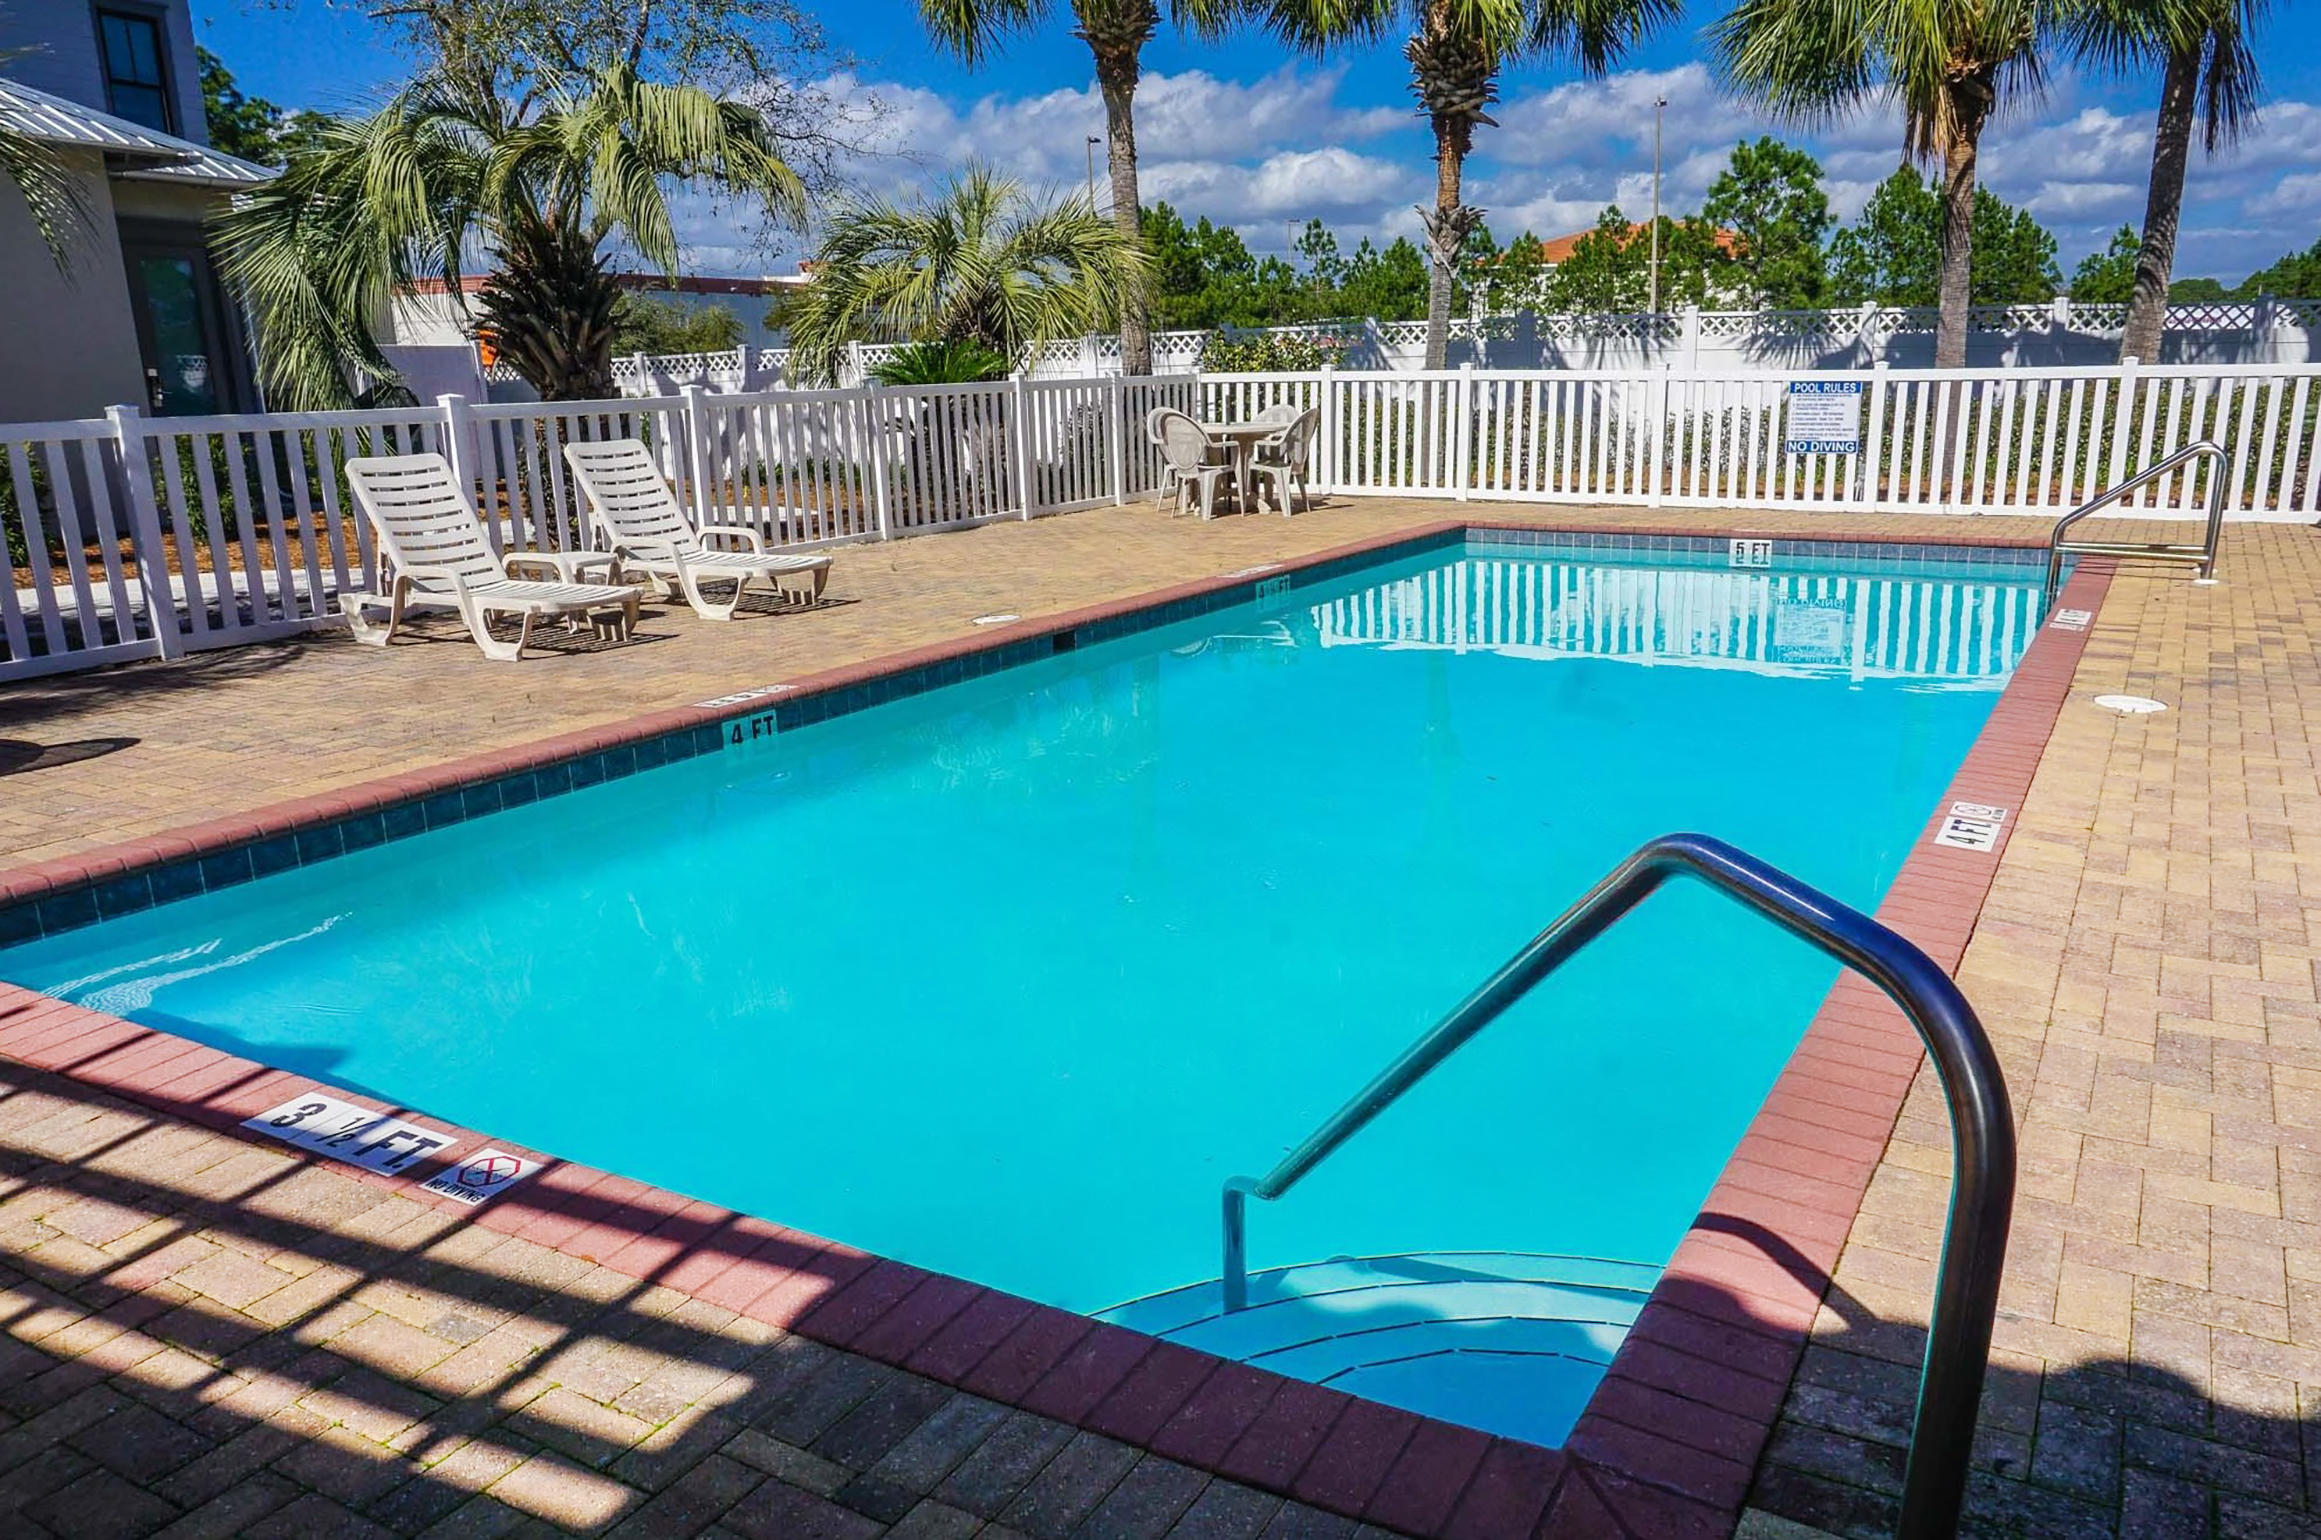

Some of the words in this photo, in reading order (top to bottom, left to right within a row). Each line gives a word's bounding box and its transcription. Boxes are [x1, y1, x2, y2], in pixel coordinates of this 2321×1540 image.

[1794, 382, 1821, 393] POOL
[1823, 382, 1857, 393] RULES
[1788, 441, 1807, 451] NO
[1810, 442, 1855, 452] DIVING
[731, 723, 744, 744] 4
[751, 715, 774, 740] FT
[1950, 818, 1992, 836] FT
[1945, 834, 1986, 845] 4
[269, 1102, 328, 1128] 3
[426, 1178, 447, 1191] NO
[443, 1182, 486, 1203] DIVING
